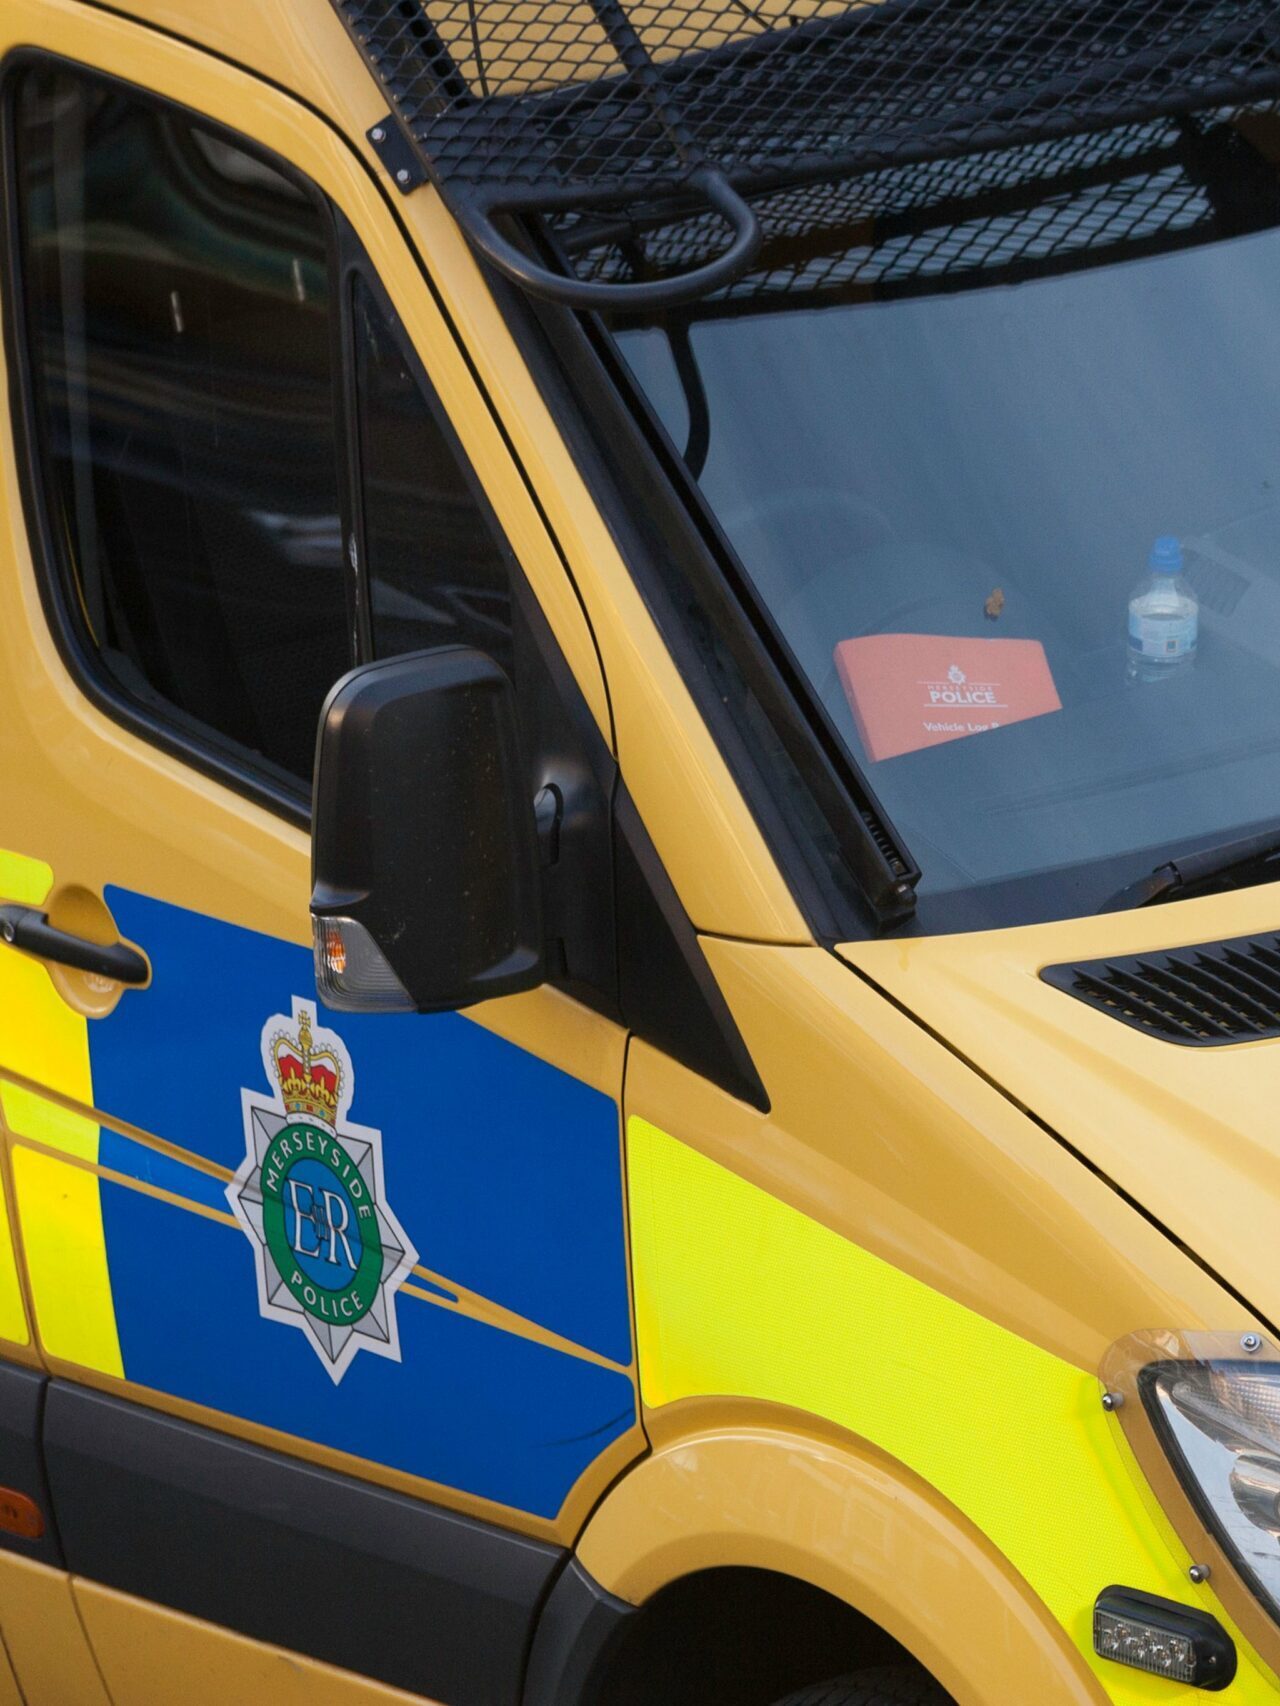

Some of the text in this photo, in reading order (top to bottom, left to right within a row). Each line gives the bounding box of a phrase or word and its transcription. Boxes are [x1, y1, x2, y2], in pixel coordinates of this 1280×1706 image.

[929, 690, 997, 704] POLICE
[923, 721, 964, 732] Vehicle
[266, 1131, 371, 1219] MERSEYSIDE
[291, 1270, 363, 1318] POLICE
